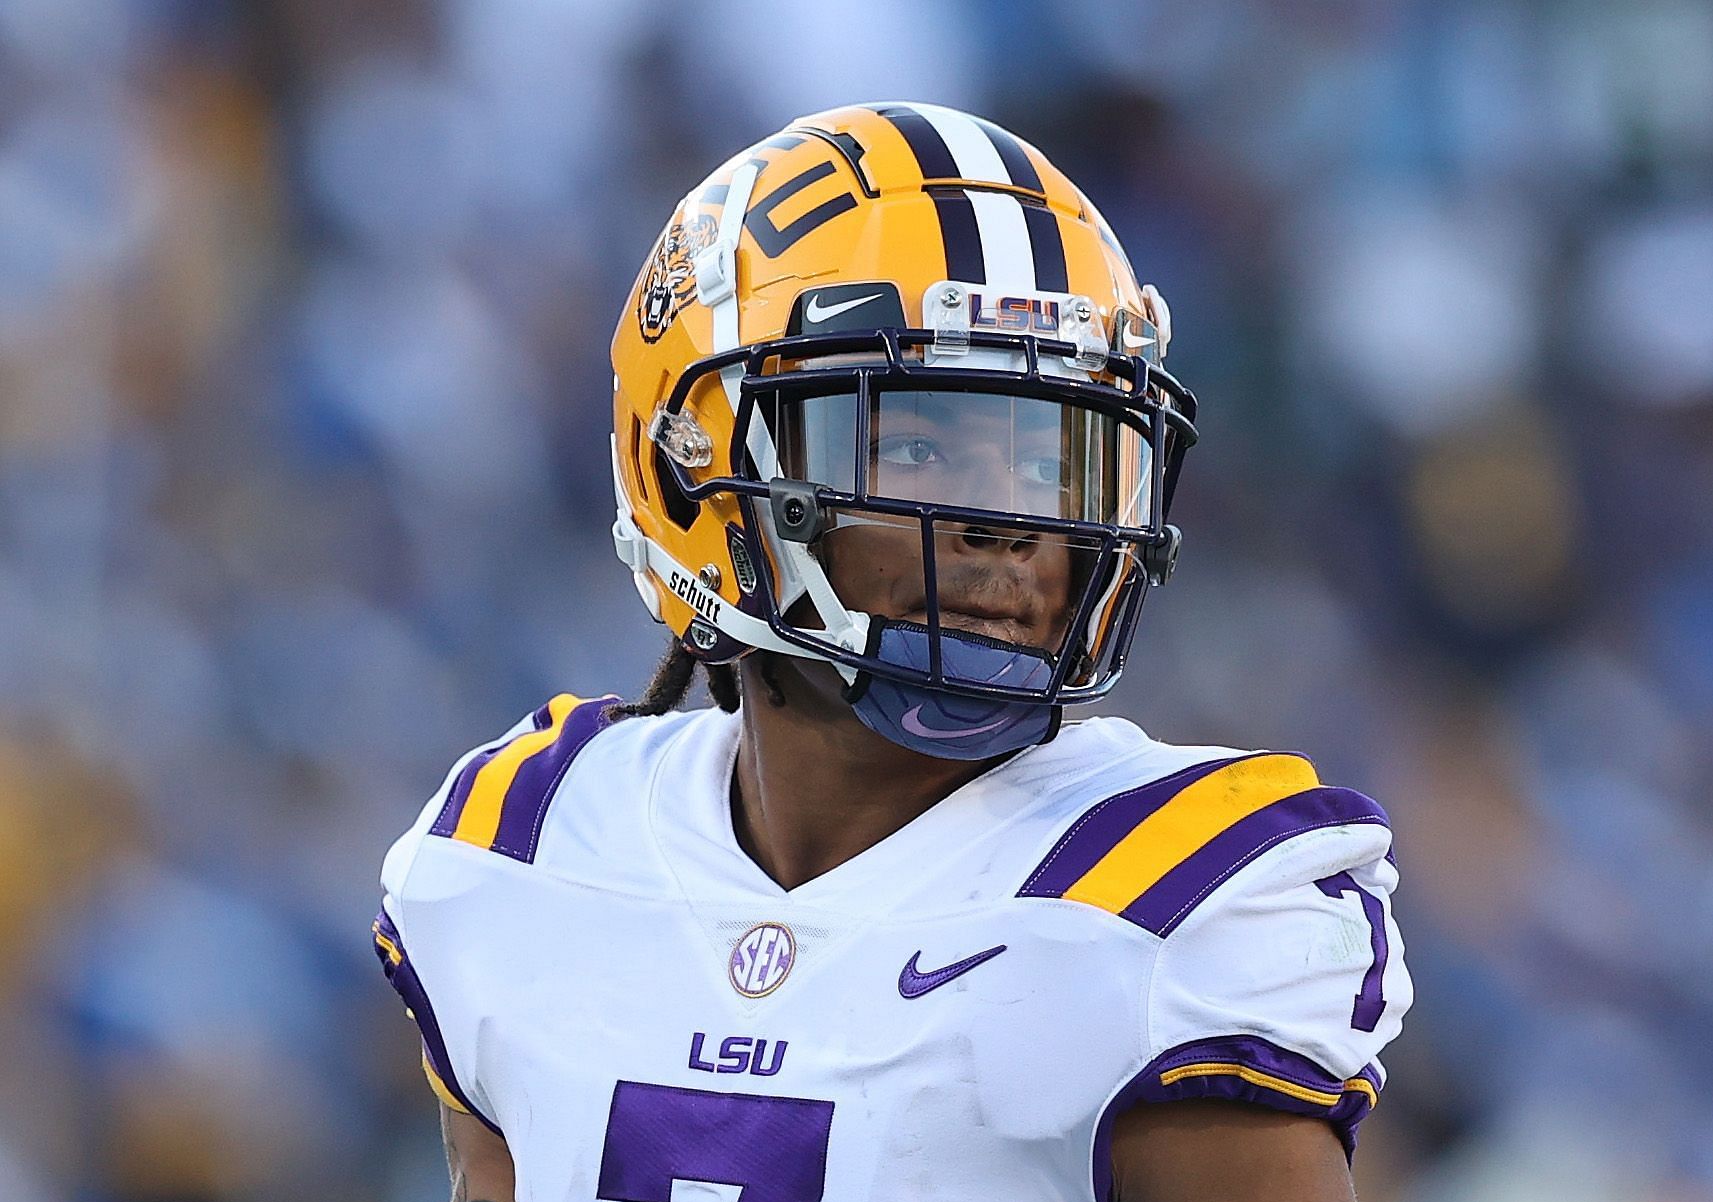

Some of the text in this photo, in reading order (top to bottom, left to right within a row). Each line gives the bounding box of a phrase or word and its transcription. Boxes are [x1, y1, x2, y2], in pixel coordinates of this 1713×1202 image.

[968, 293, 1060, 334] LSU
[669, 571, 720, 624] schutt
[733, 926, 791, 991] SEC
[688, 1032, 789, 1077] LSU
